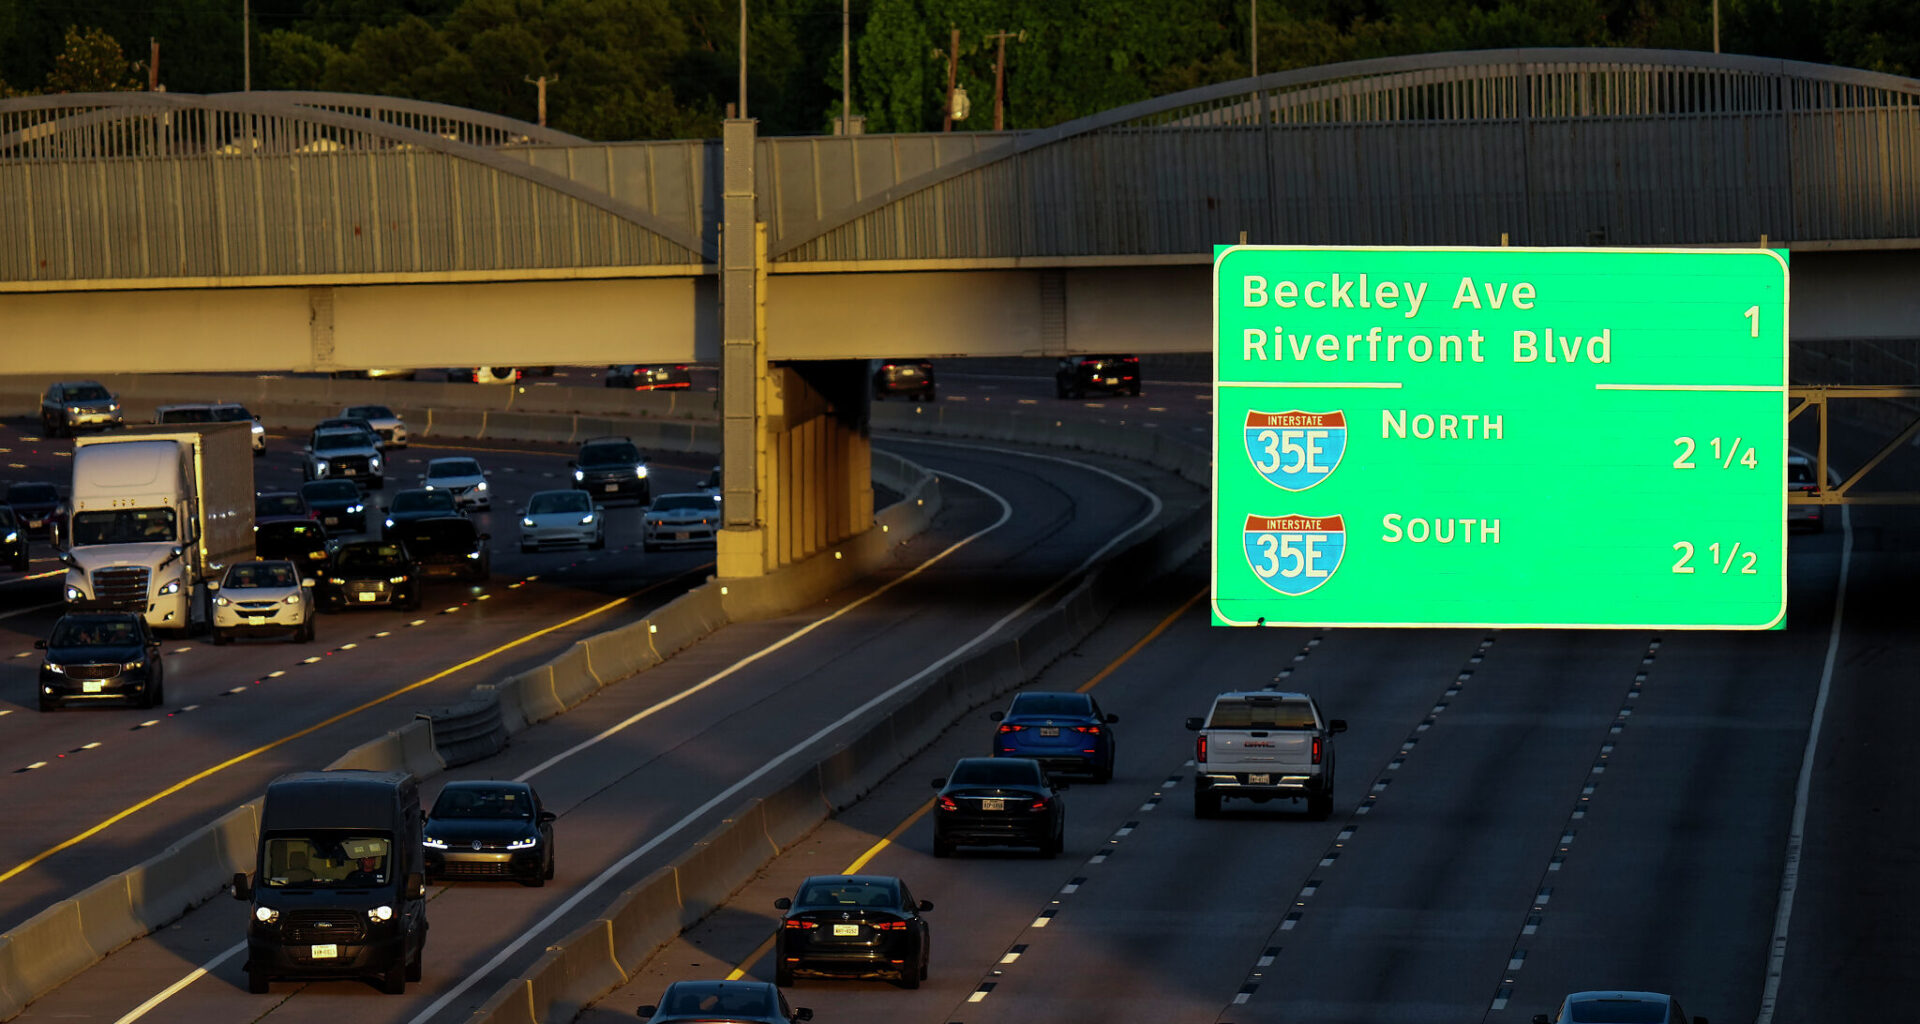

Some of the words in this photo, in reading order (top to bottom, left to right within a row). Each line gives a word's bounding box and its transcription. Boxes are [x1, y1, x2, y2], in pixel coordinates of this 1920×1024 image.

[1243, 273, 1428, 319] Beckley
[1452, 277, 1537, 310] Ave
[1744, 305, 1760, 338] 1
[1243, 326, 1485, 363] Riverfront
[1513, 328, 1612, 364] Blvd
[1267, 415, 1323, 426] INTERSTATE
[1256, 430, 1329, 474] 35E
[1266, 519, 1322, 530] INTERSTATE
[1255, 534, 1328, 578] 35E
